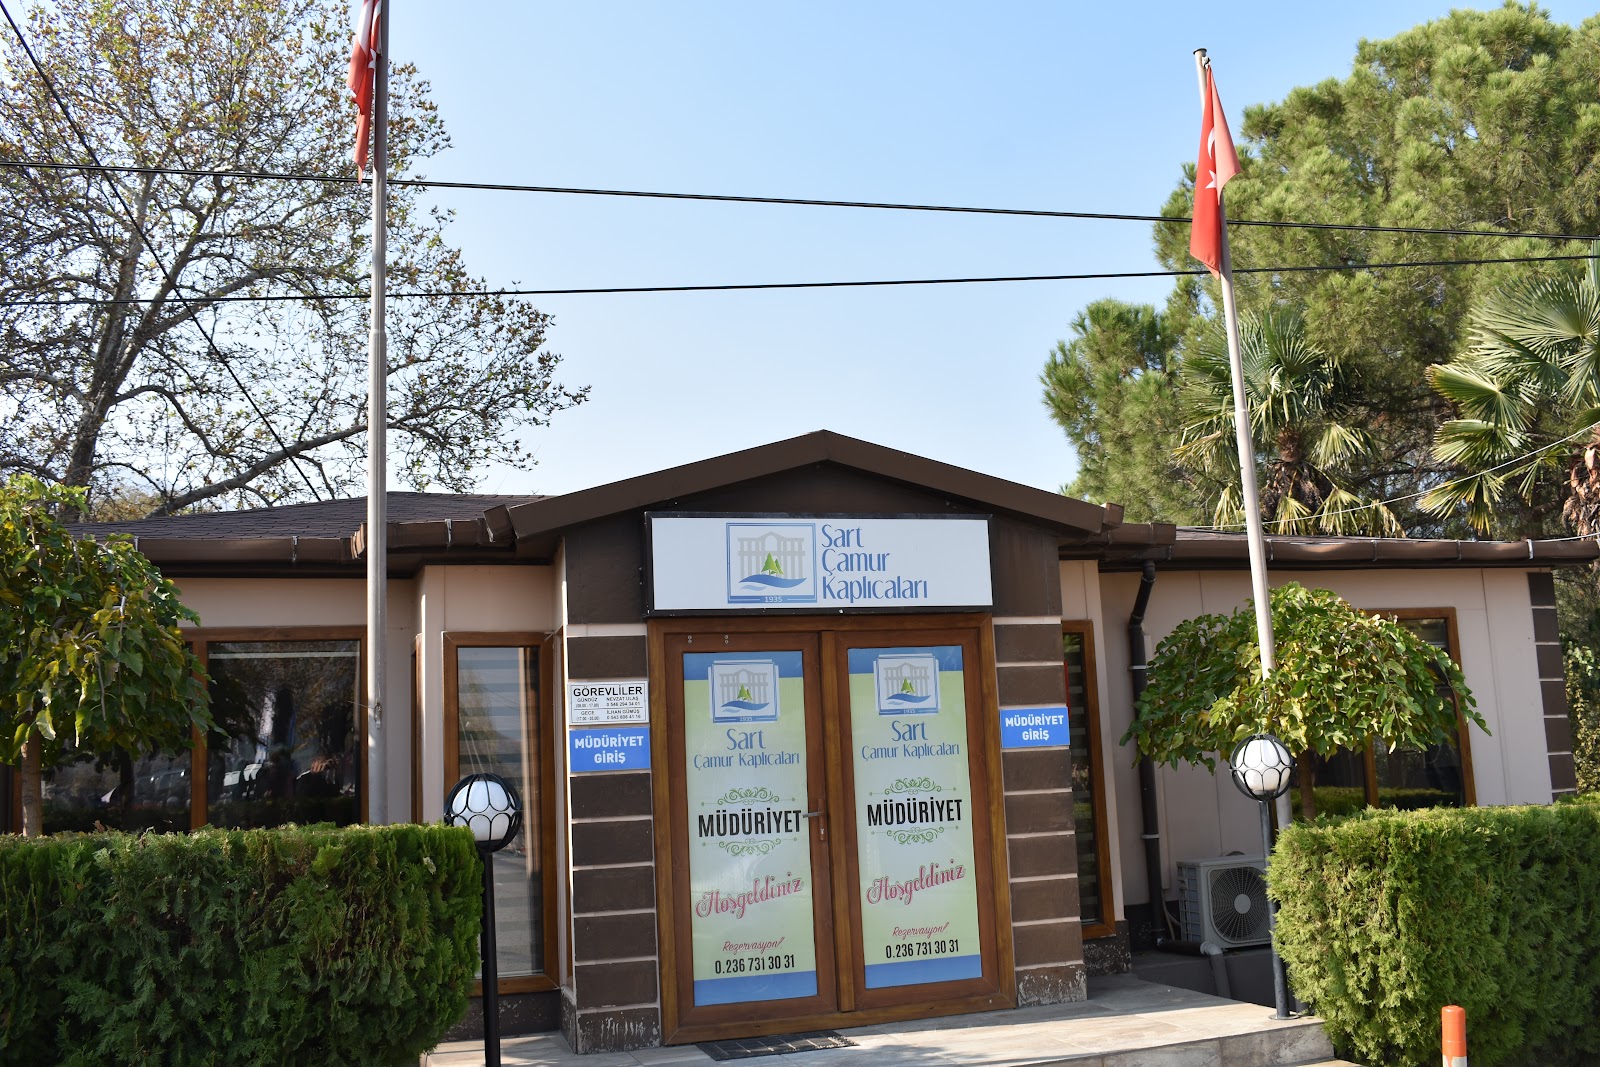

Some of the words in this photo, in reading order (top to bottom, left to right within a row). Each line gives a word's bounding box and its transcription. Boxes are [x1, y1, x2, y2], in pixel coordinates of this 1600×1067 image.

[821, 524, 865, 549] Sart
[821, 549, 890, 576] Çamur
[822, 575, 928, 603] Kaplıcaları
[573, 685, 643, 697] GÖREVLİLER
[1005, 713, 1064, 727] MÜDÜRİYET
[574, 734, 644, 749] MÜDÜRİYET
[726, 728, 766, 750] Sart
[891, 720, 928, 742] Sart
[1022, 728, 1050, 741] GİRİŞ
[594, 750, 626, 763] GİRİŞ
[693, 753, 734, 770] Çamur
[739, 751, 800, 768] Kaplıcaları
[861, 745, 899, 761] Çamur
[903, 742, 960, 760] Kaplıcaları
[867, 796, 962, 826] MÜDÜRİYET
[698, 807, 802, 837] MÜDÜRİYET
[866, 859, 966, 905] Hoşgeldiniz
[695, 872, 804, 919] Hoşgeldiniz
[885, 943, 914, 959] 0.236
[916, 941, 932, 956] 731
[934, 940, 947, 954] 30
[949, 939, 959, 953] 31
[714, 958, 745, 974] 0.236
[748, 956, 765, 972] 731
[768, 955, 781, 970] 30
[784, 954, 795, 968] 31
